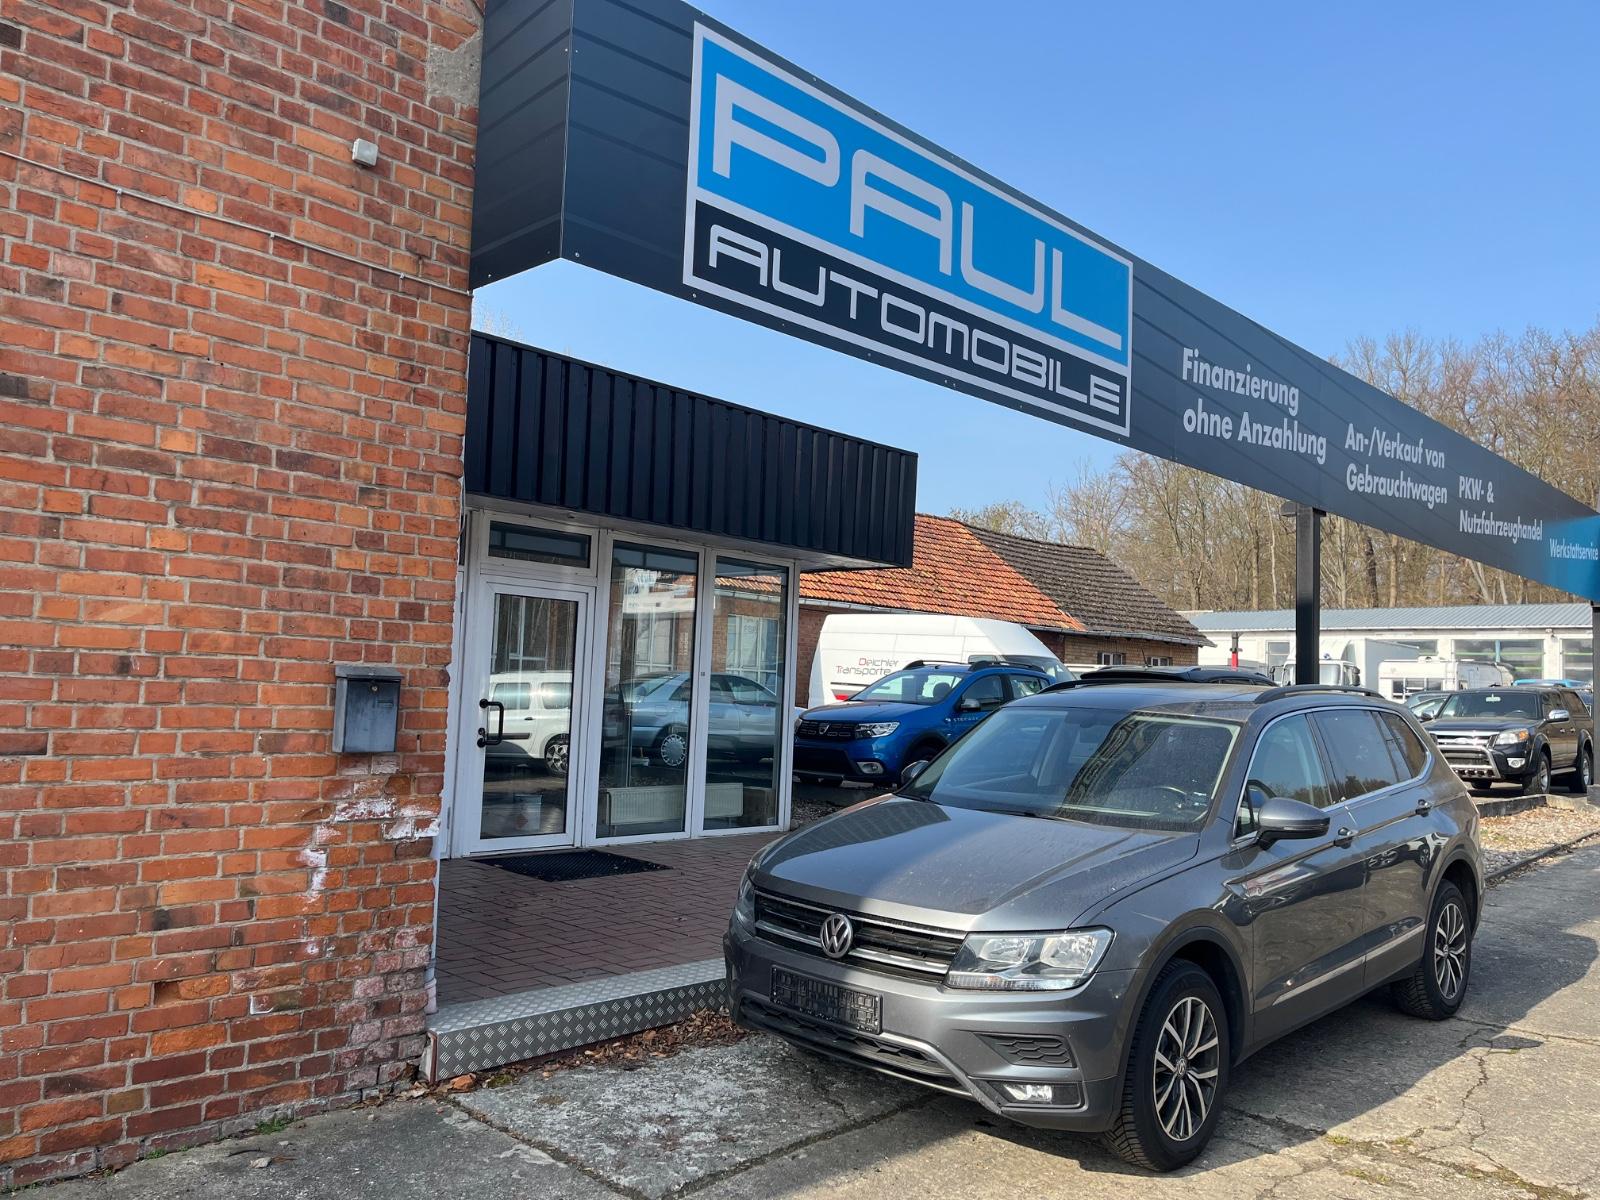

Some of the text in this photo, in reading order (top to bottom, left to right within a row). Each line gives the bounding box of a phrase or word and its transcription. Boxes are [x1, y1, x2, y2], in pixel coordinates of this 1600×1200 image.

[713, 73, 1122, 350] PAUL
[709, 224, 1120, 415] AUTOMOBILE
[1182, 347, 1299, 417] Finanzierung
[1183, 398, 1327, 465] ohne Anzahlung
[1345, 423, 1445, 469] An-/Verkauf von
[1346, 463, 1448, 510] Gebrauchtwagen
[1459, 475, 1495, 503] PKW- &
[1460, 509, 1543, 544] Nutzfahrzeughandel
[1550, 538, 1599, 560] Werkstattservice
